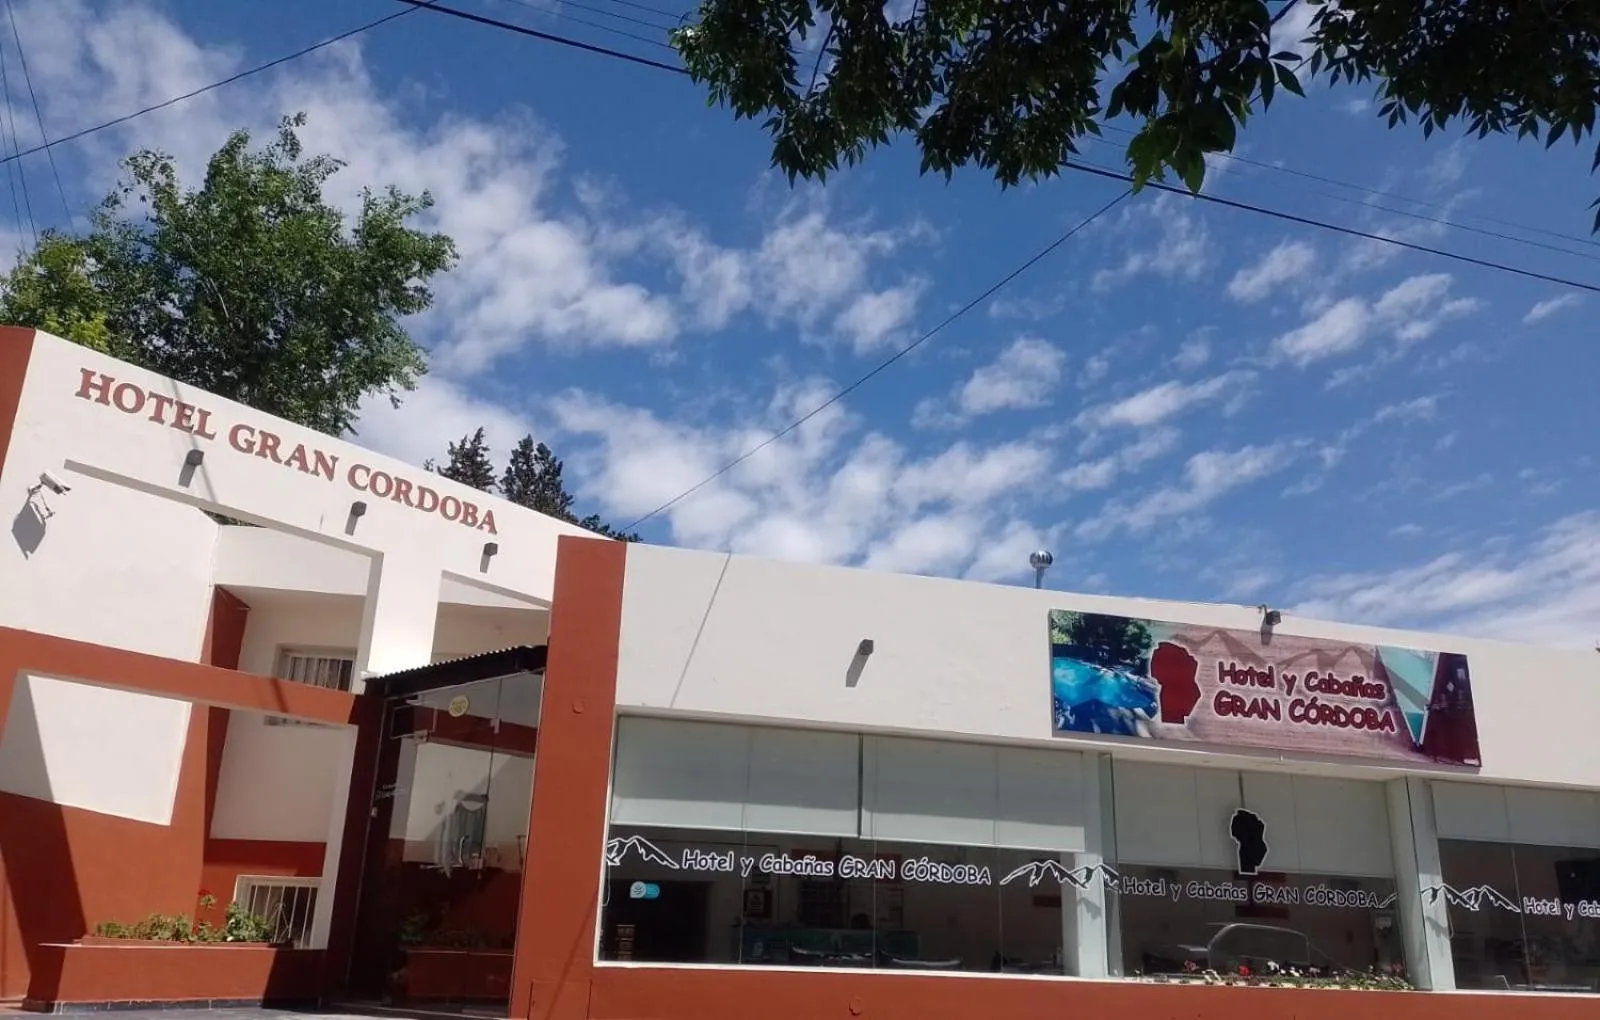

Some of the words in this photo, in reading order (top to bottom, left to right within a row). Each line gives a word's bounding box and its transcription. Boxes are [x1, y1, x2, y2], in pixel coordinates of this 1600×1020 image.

[75, 367, 216, 440] HOTEL
[228, 424, 340, 482] GRAN
[347, 463, 498, 534] CORDOBA
[1217, 661, 1275, 689] Hotel
[1282, 673, 1297, 697] y
[1304, 671, 1386, 699] Cabañas
[1213, 690, 1281, 721] GRAN
[1288, 696, 1397, 733] CÓRDOBA
[681, 849, 734, 872] Hotel
[740, 857, 753, 878] y
[759, 853, 834, 876] Cabañas
[838, 856, 896, 879] GRAN
[901, 855, 992, 885] CÓRDOBA
[1123, 876, 1166, 897] Hotel
[1171, 883, 1183, 902] y
[1186, 881, 1247, 901] Cabañas
[1253, 882, 1300, 904] GRAN
[1304, 883, 1380, 908] CÓRDOBA
[1523, 896, 1561, 916] Hotel
[1564, 903, 1575, 920] y
